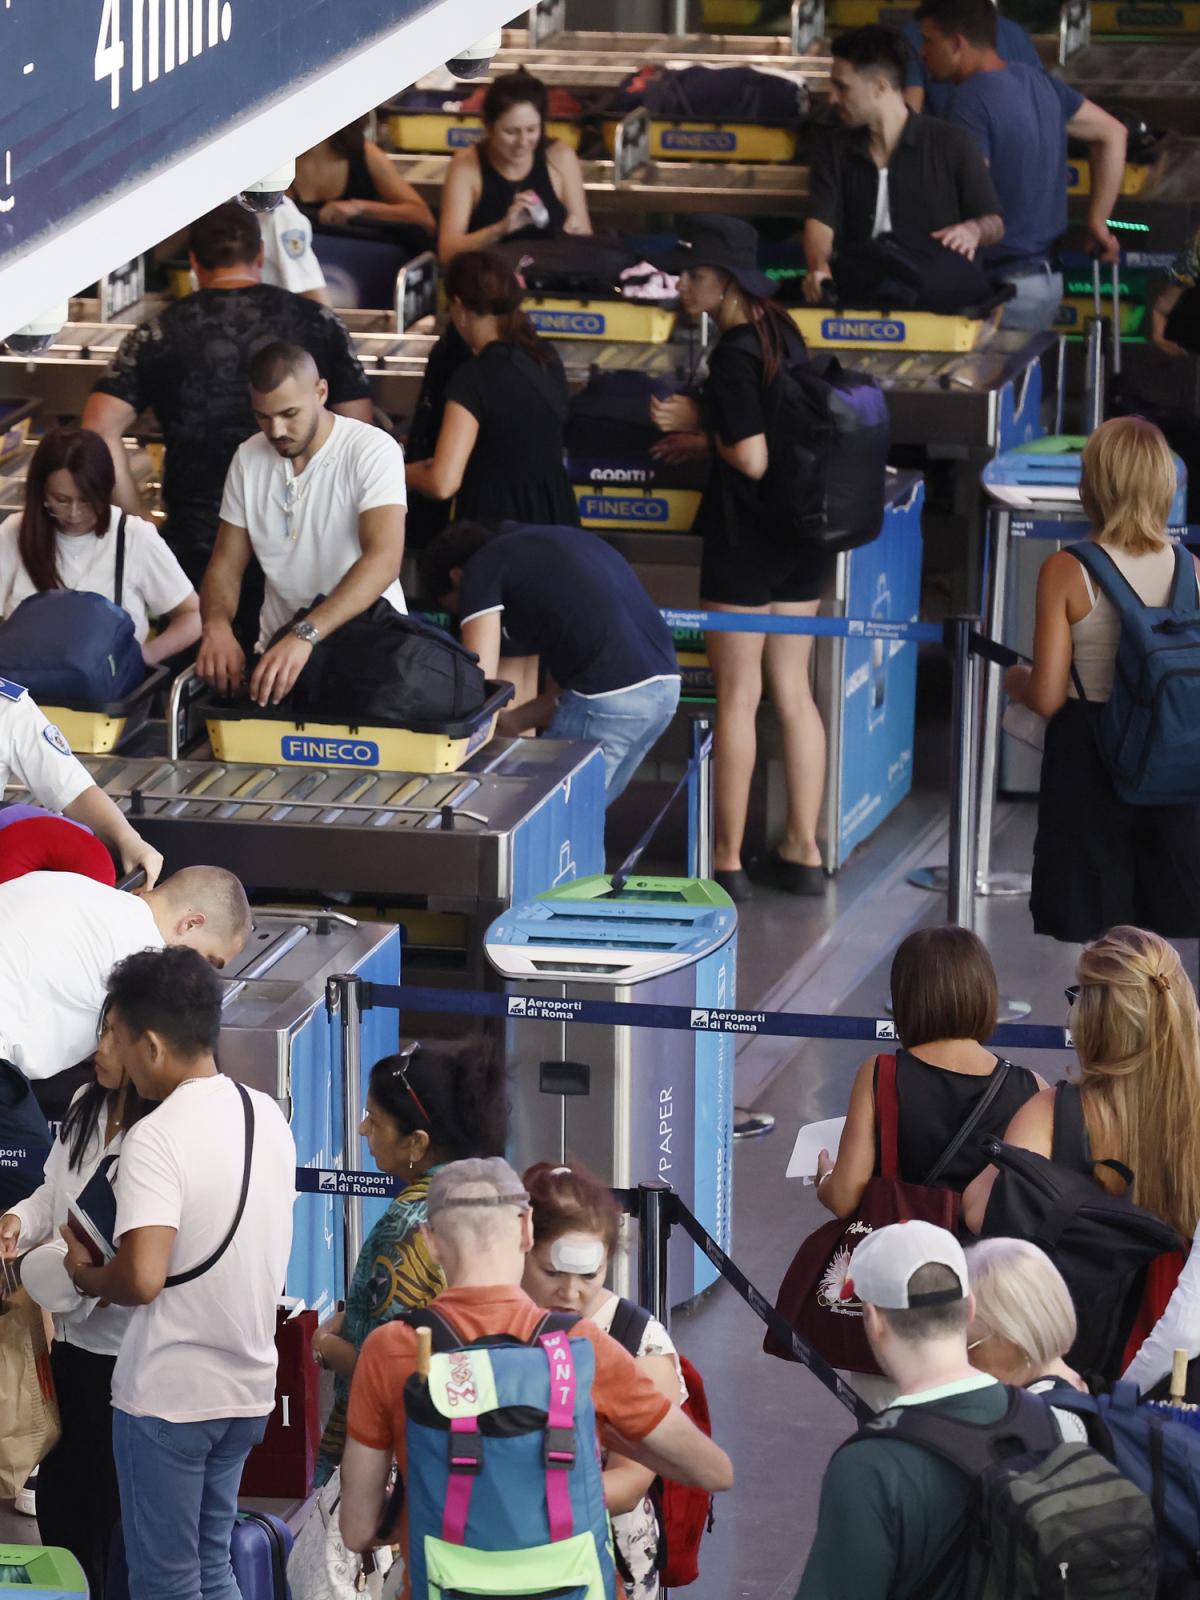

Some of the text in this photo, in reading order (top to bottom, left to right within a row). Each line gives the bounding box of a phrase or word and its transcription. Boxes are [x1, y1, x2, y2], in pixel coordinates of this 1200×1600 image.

[828, 321, 899, 338] FINECO
[586, 500, 662, 517] FINECO
[288, 741, 372, 762] FINECO
[527, 998, 582, 1011] Aeroporti
[528, 1007, 574, 1019] di Roma
[711, 1011, 766, 1024] Aeroporti
[710, 1020, 757, 1032] di Roma
[338, 1173, 394, 1185] Aeroporti
[338, 1183, 386, 1195] di Roma
[544, 1336, 571, 1405] WANT
